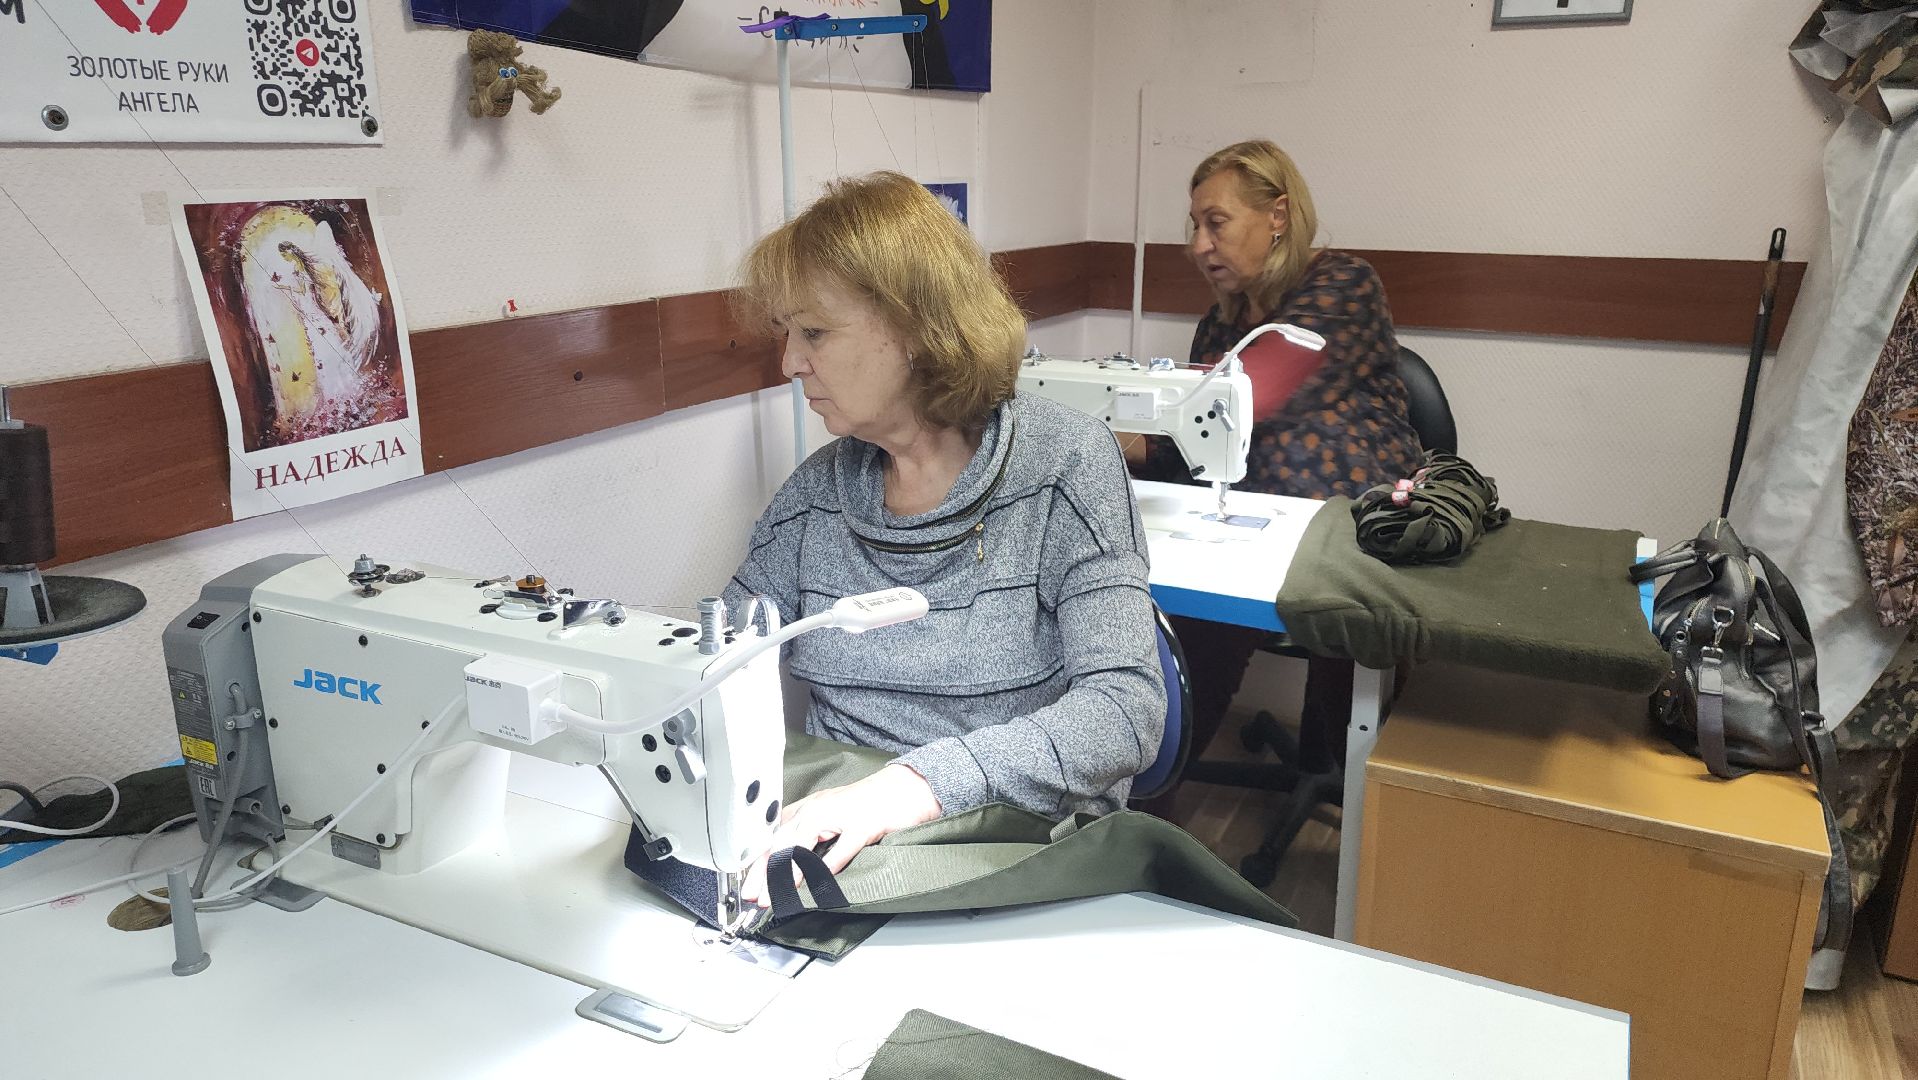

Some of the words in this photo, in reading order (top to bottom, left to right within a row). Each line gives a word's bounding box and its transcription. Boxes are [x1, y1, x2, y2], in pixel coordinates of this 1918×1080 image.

[67, 55, 170, 82] ЗОЛОТЫЕ
[177, 61, 230, 83] РУКИ
[118, 91, 200, 113] АНГЕЛА
[254, 436, 408, 490] НАДЕЖДА
